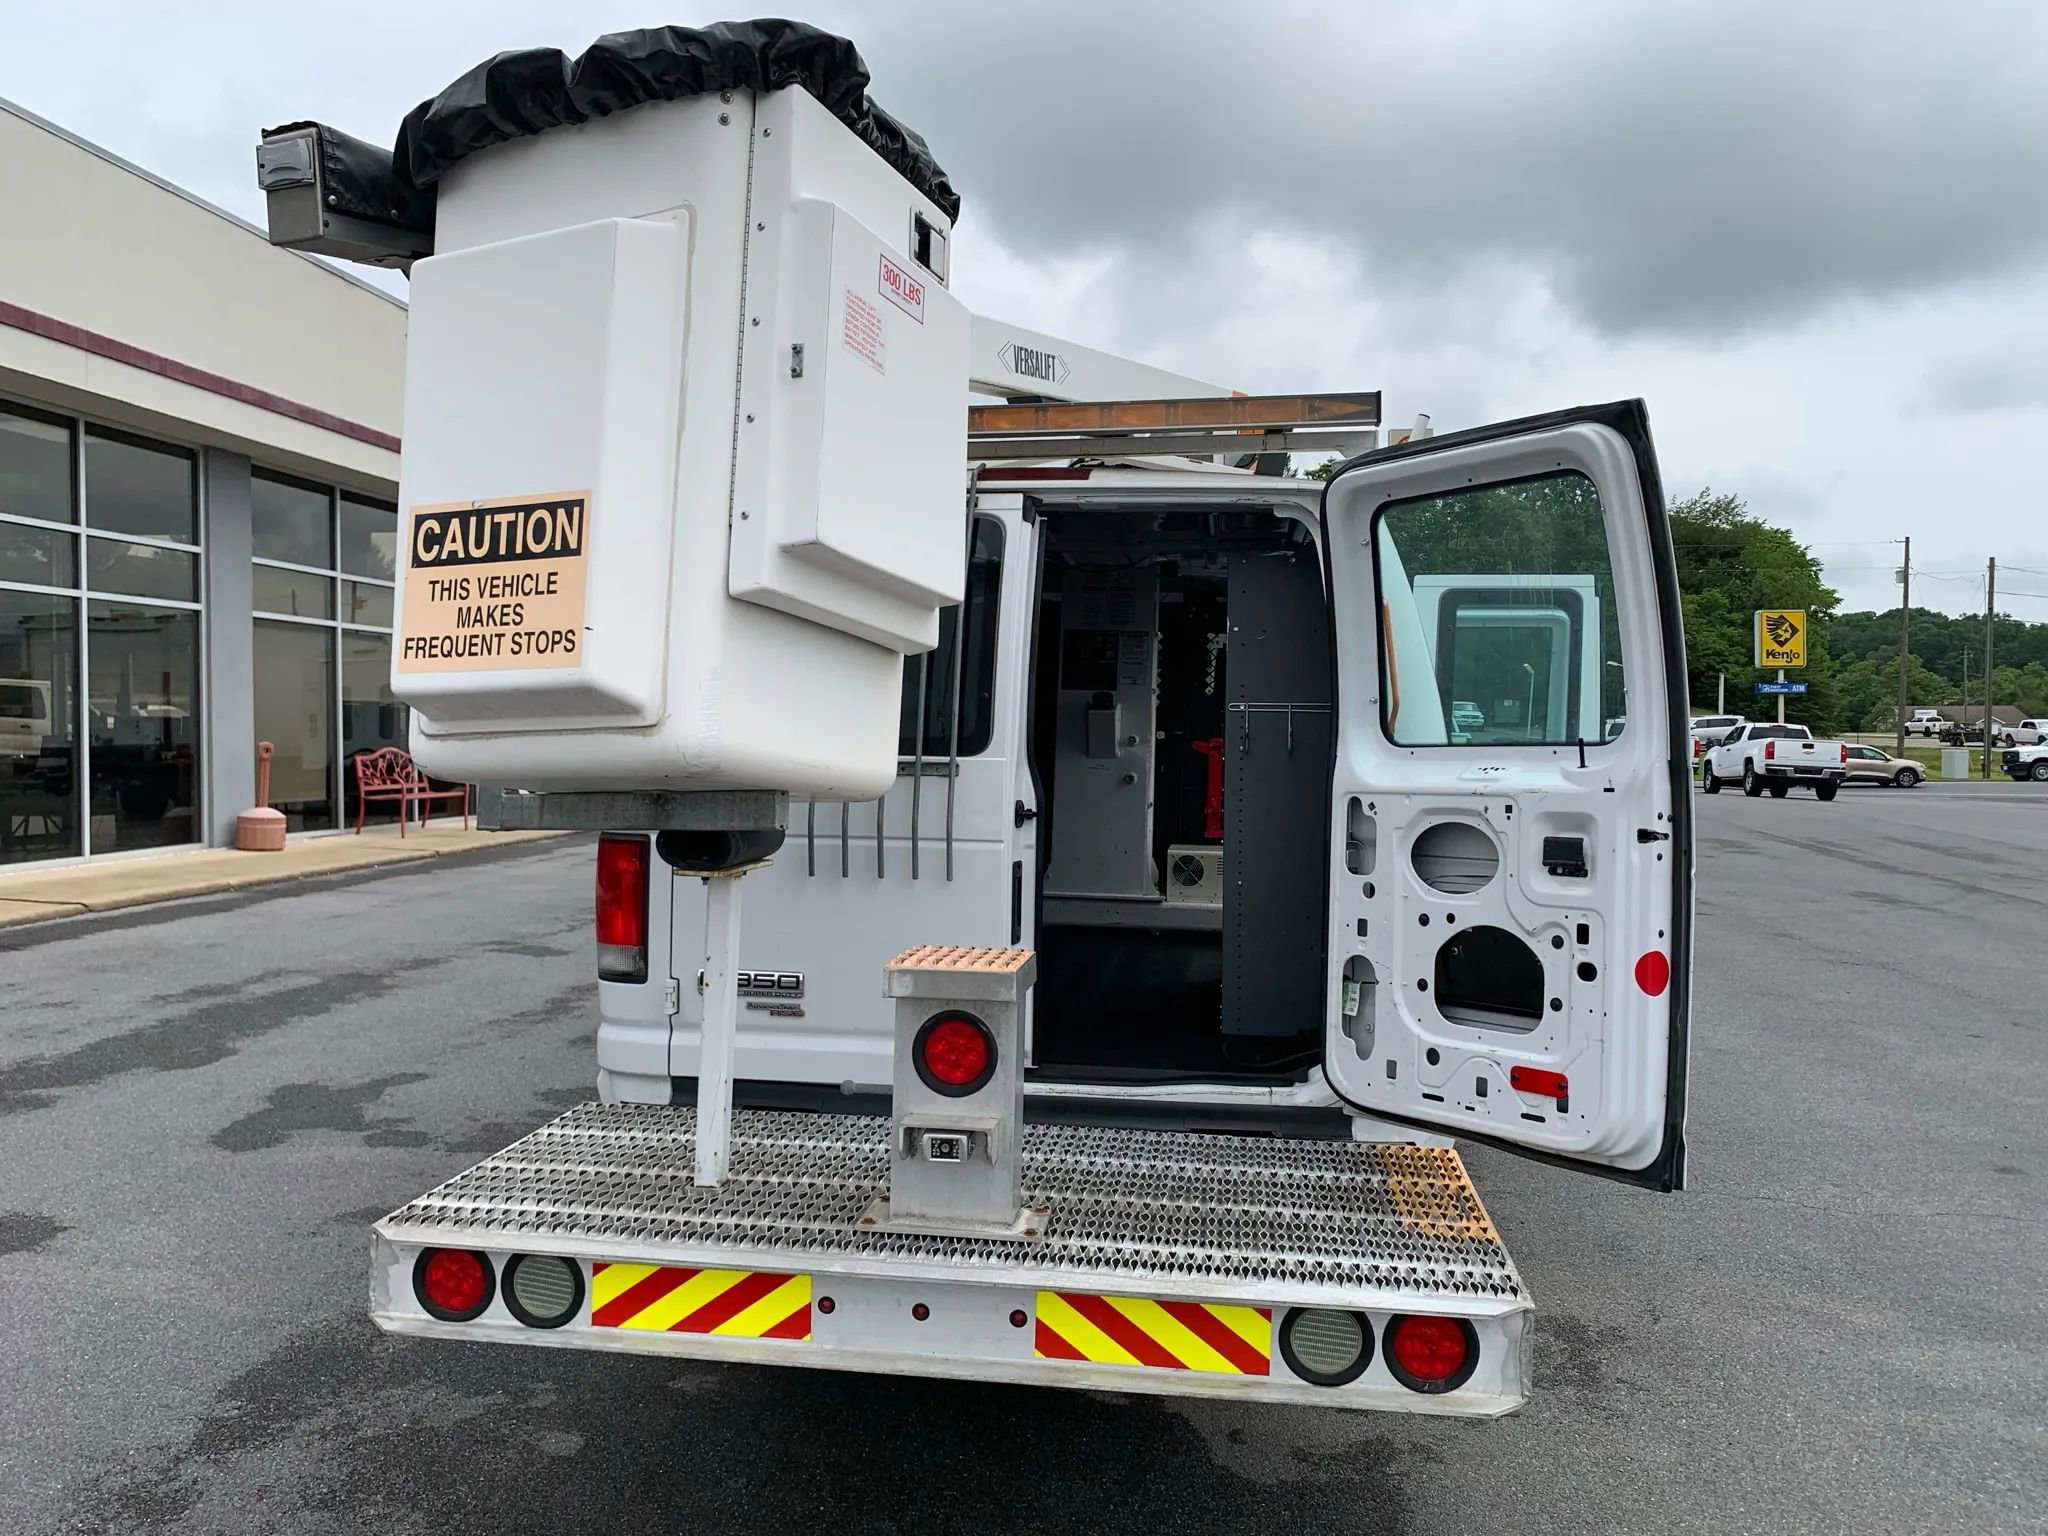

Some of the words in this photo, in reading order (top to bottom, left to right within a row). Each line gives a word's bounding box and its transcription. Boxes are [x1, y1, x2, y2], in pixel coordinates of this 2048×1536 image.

[883, 264, 901, 290] 300
[903, 278, 921, 306] LBS
[1013, 344, 1056, 382] VERSALIFT
[416, 506, 580, 562] CAUTION
[428, 578, 470, 602] THIS
[477, 571, 558, 599] VEHICLE
[456, 602, 524, 629] MAKES
[403, 632, 506, 659] FREQUENT
[510, 629, 576, 655] STOPS
